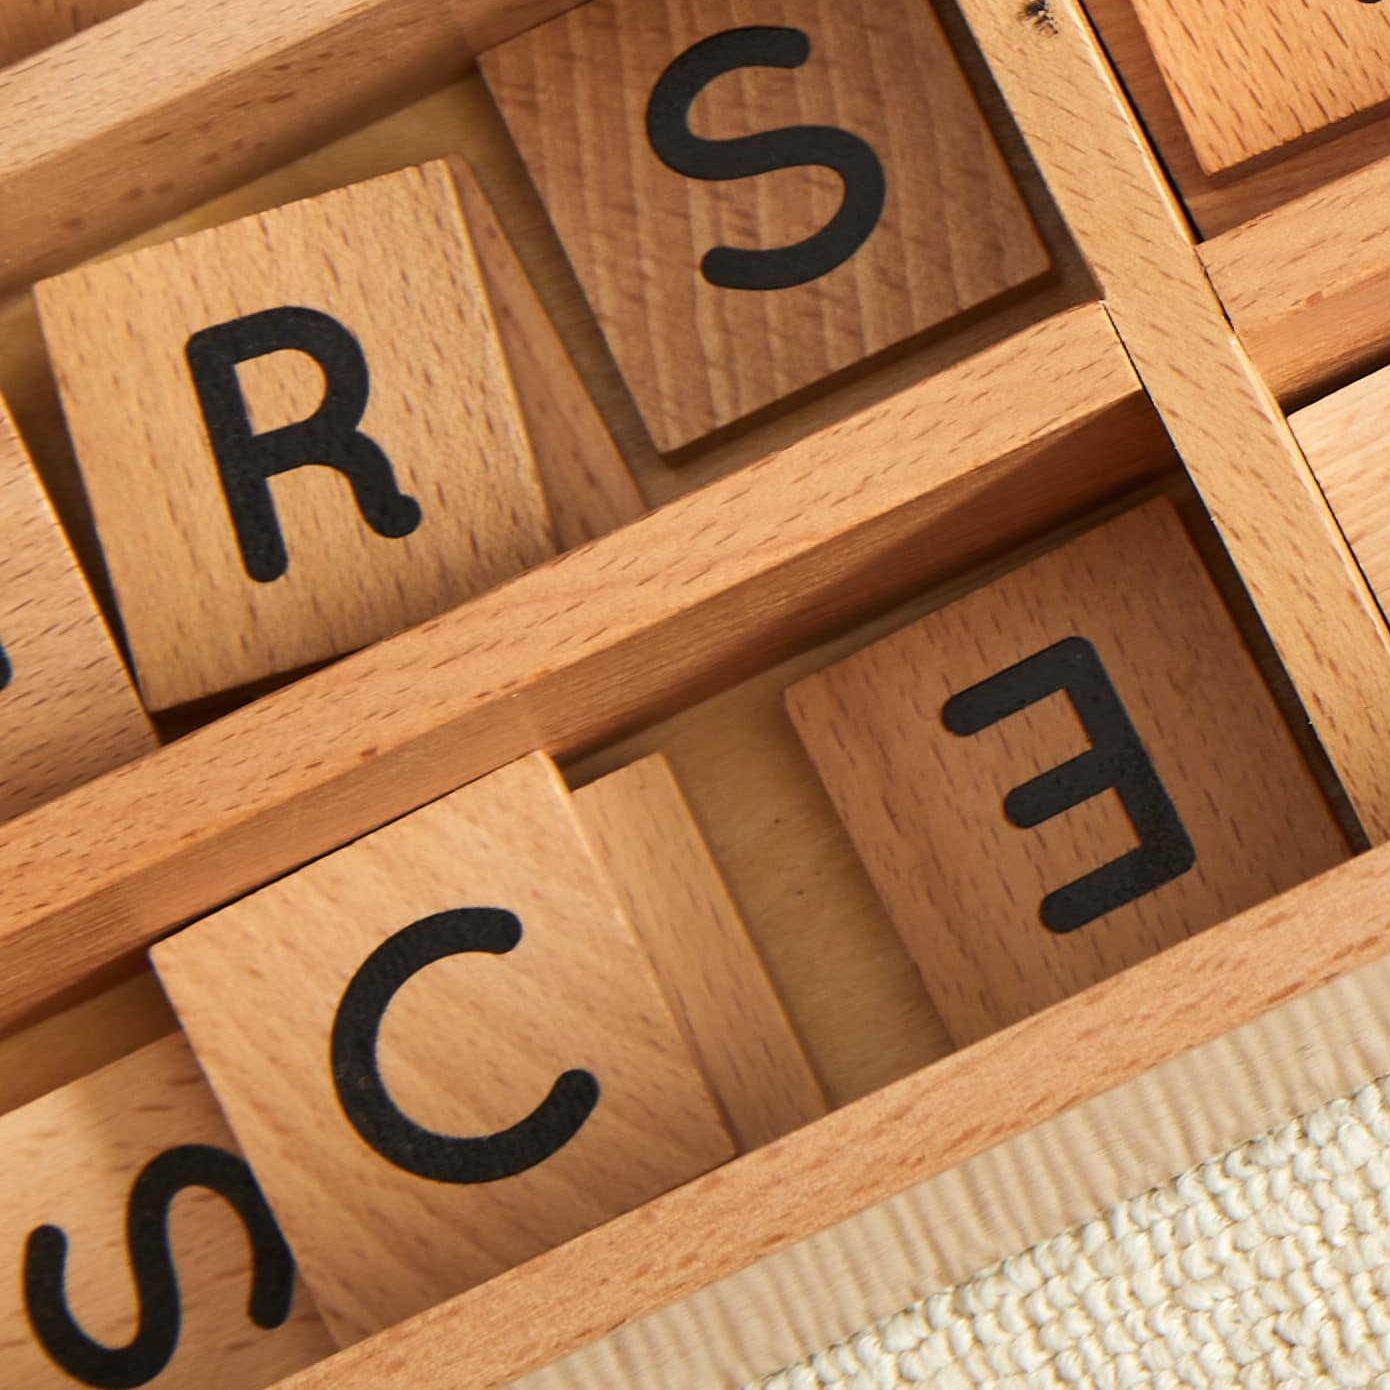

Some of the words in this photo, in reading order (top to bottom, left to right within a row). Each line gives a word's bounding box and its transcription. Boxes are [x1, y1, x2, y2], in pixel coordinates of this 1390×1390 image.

[645, 25, 886, 291] S
[186, 307, 421, 582] R
[941, 636, 1197, 934] E
[332, 908, 600, 1185] C
[25, 1144, 297, 1390] S
